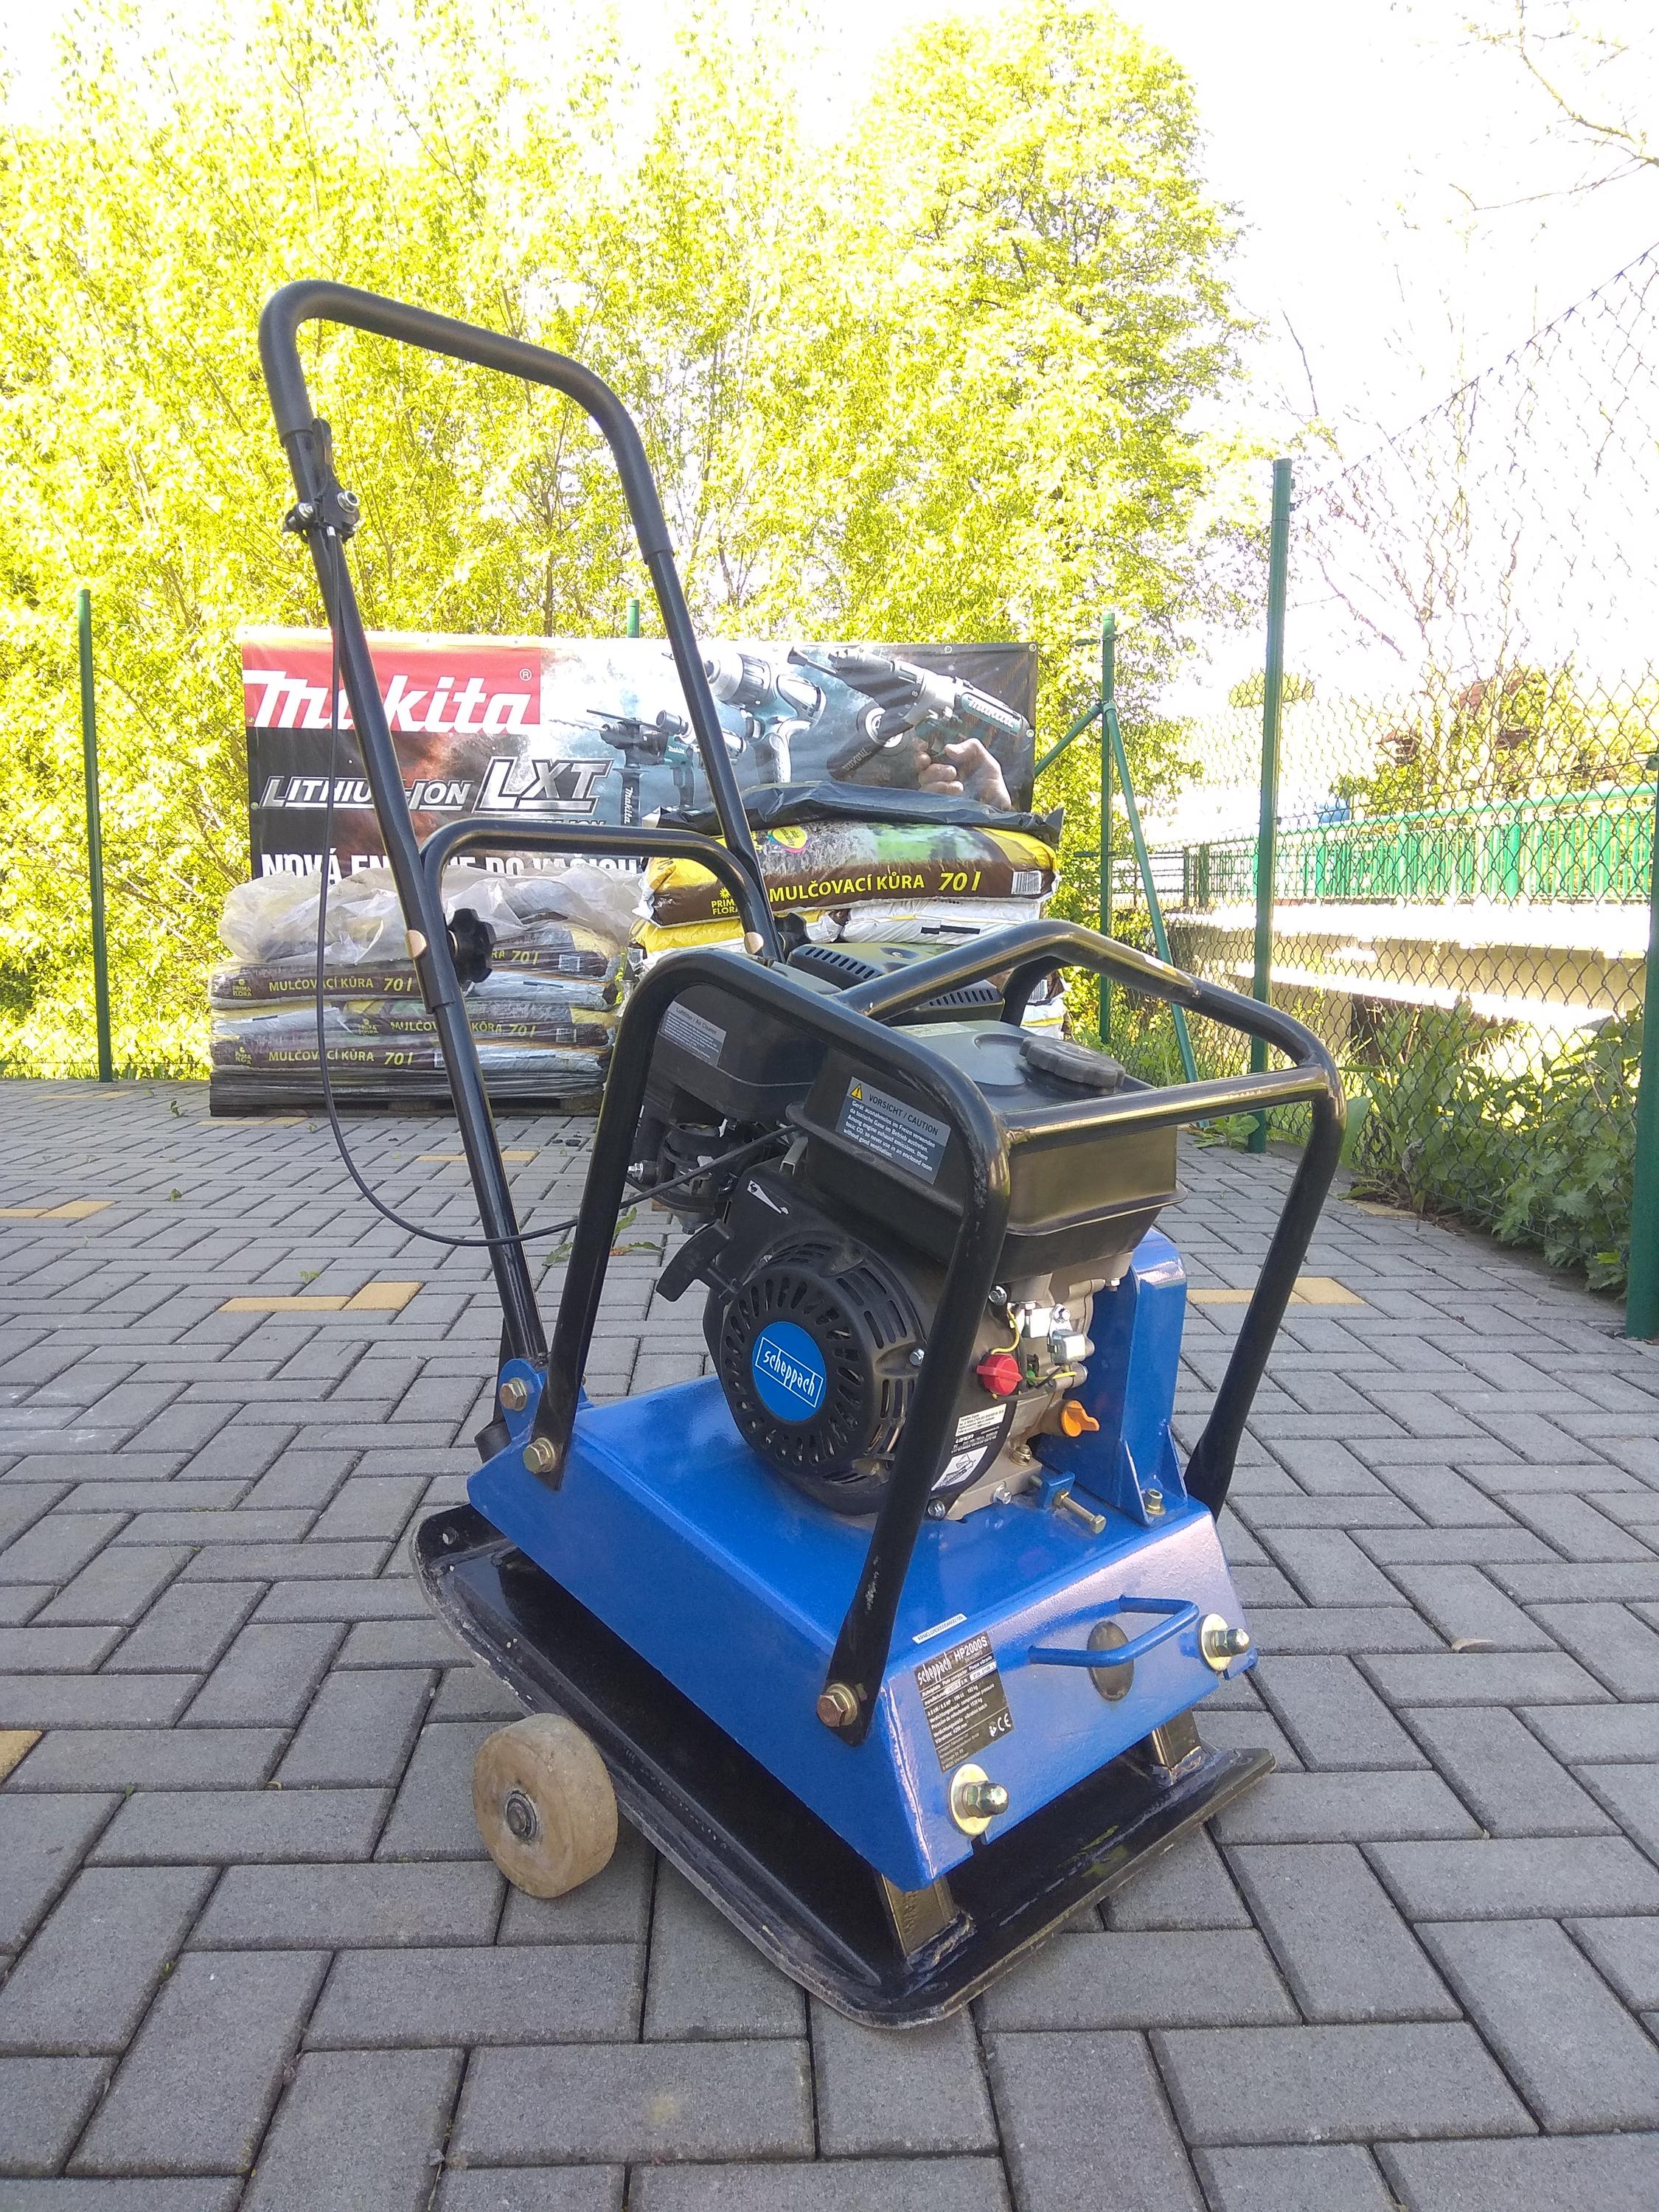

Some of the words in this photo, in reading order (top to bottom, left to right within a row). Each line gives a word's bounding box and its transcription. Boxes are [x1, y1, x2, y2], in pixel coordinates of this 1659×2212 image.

[258, 778, 473, 810] LITHIU-ION
[475, 757, 613, 813] LXT
[769, 873, 872, 902] MULČOVACÍ
[877, 871, 925, 891] KŮRA
[938, 872, 969, 891] 70
[711, 899, 735, 908] PRIM
[510, 950, 530, 963] 70
[268, 976, 338, 992] MULČOVCÍ
[383, 978, 403, 992] 70
[509, 1023, 527, 1037] 70
[268, 1049, 338, 1062] MULČOVCÍ
[383, 1051, 404, 1065] 70
[869, 1094, 902, 1116] VORSICHT
[908, 1114, 938, 1135] CAUTION
[848, 1114, 862, 1125] Among
[863, 1122, 877, 1133] engine
[877, 1130, 894, 1142] exhaust
[874, 1119, 885, 1129] Gase
[891, 1129, 907, 1141] Betrieb
[899, 1125, 912, 1135] Freien
[859, 1136, 869, 1146] good
[871, 1134, 882, 1144] never
[922, 1162, 932, 1172] room
[762, 1349, 815, 1397] scheppach
[917, 1652, 953, 1686] scheppach
[953, 1635, 988, 1662] HP2000S
